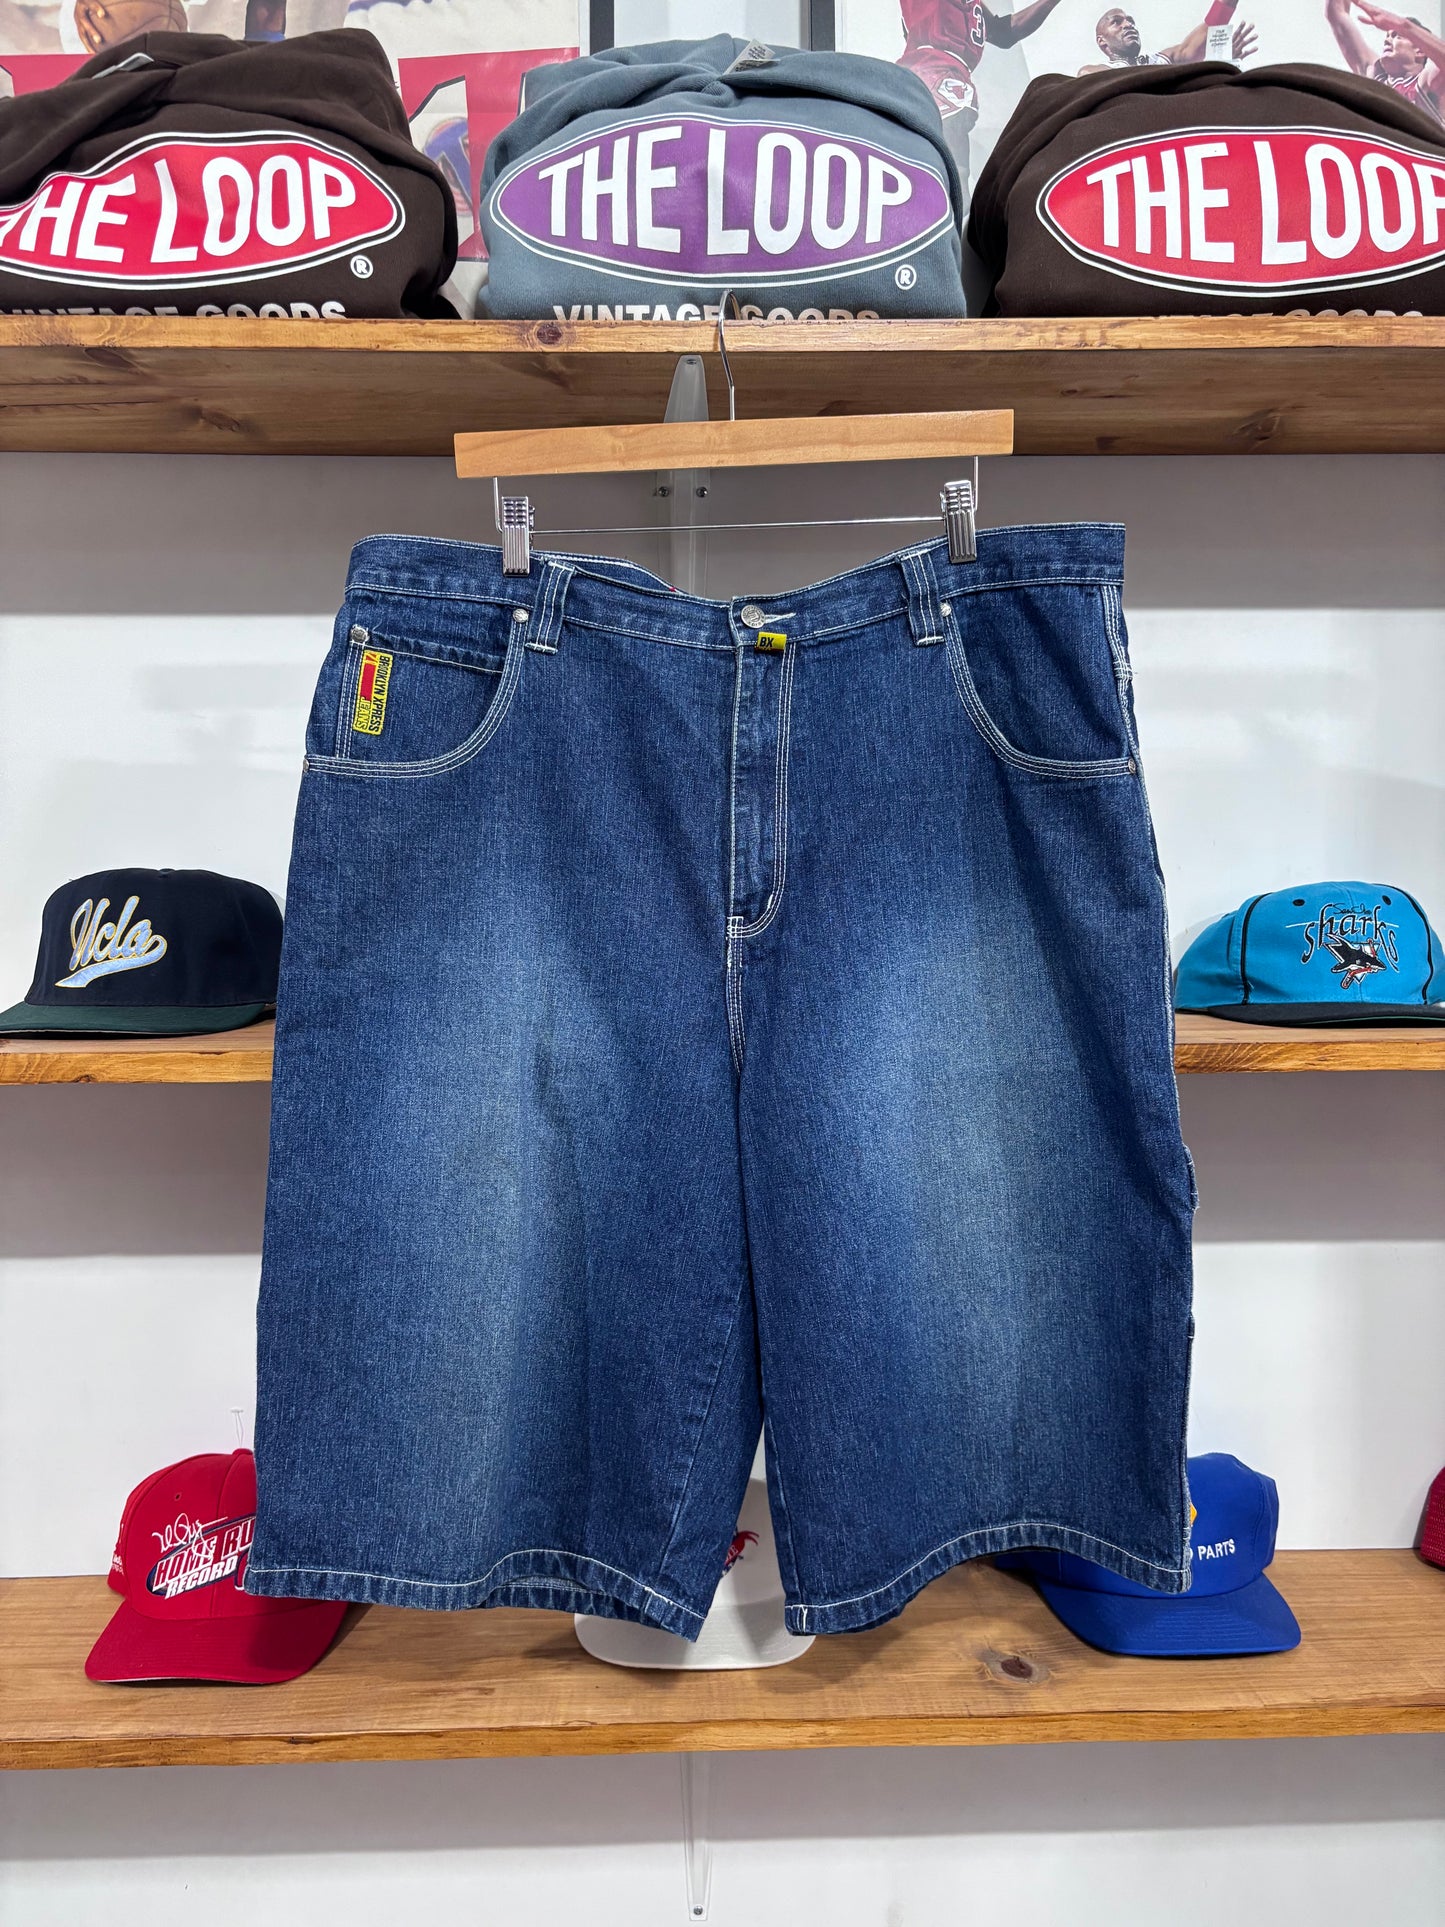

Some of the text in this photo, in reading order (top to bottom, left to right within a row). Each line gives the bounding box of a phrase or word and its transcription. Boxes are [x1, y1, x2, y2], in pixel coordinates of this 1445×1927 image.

[150, 155, 356, 263] LOOP
[538, 125, 912, 256] THE LOOP
[1086, 140, 1445, 265] THE LOOP
[760, 636, 774, 648] BX
[355, 696, 372, 730] JEANS
[368, 655, 391, 733] BROOKLYN XPRESS
[152, 1535, 218, 1592] HOME
[221, 1519, 256, 1561] RU
[165, 1555, 239, 1600] RECORD
[1197, 1538, 1236, 1561] PARTS
